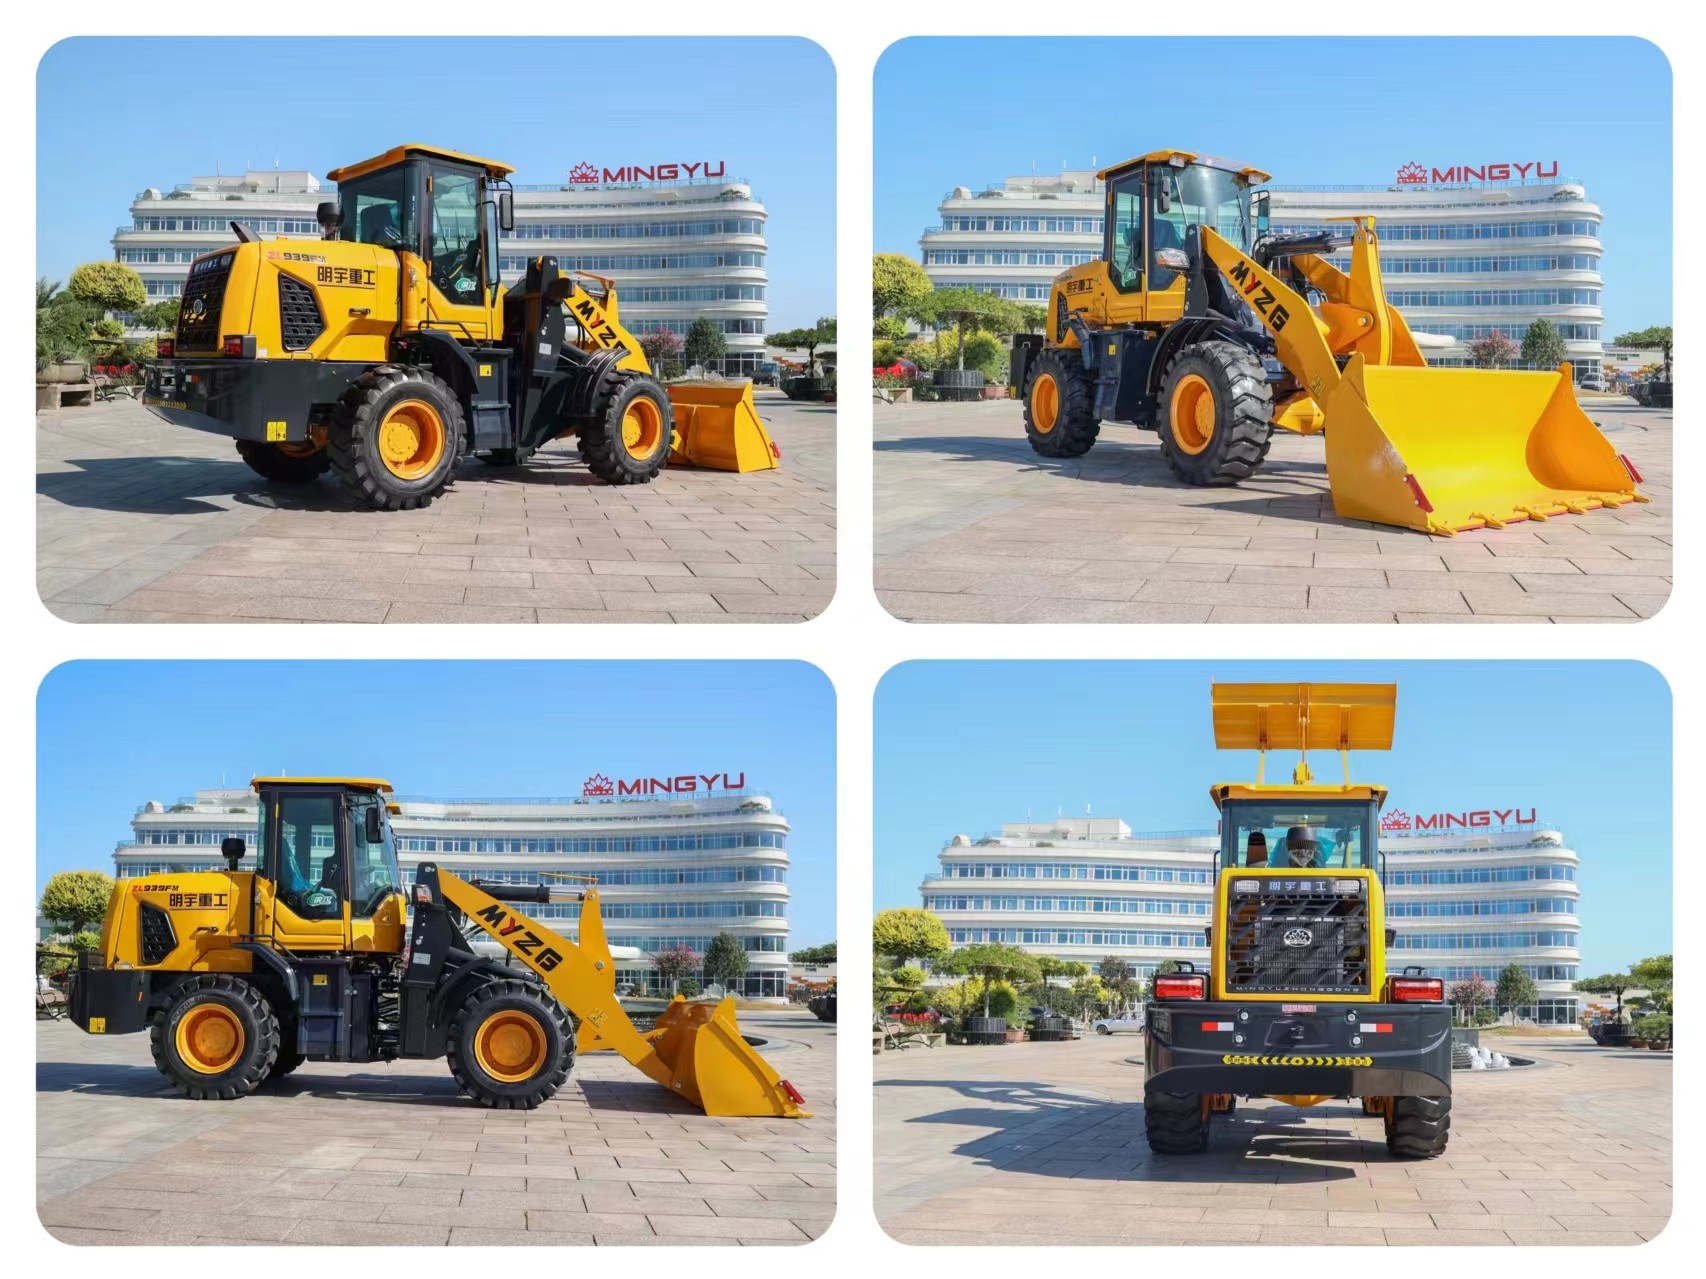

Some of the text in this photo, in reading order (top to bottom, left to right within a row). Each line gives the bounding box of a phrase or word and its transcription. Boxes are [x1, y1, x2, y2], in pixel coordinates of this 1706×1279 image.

[603, 161, 725, 183] MINGYU
[1432, 160, 1558, 183] MINGYU
[317, 265, 376, 286] 明宇重工
[1229, 260, 1290, 332] MYZG
[618, 772, 745, 796] MINGYU
[1415, 807, 1536, 830] MINGYU
[131, 884, 180, 892] ZL939FM
[1269, 881, 1327, 891] 明宇重工
[169, 893, 228, 907] 明宇重工
[476, 904, 563, 972] MYZG
